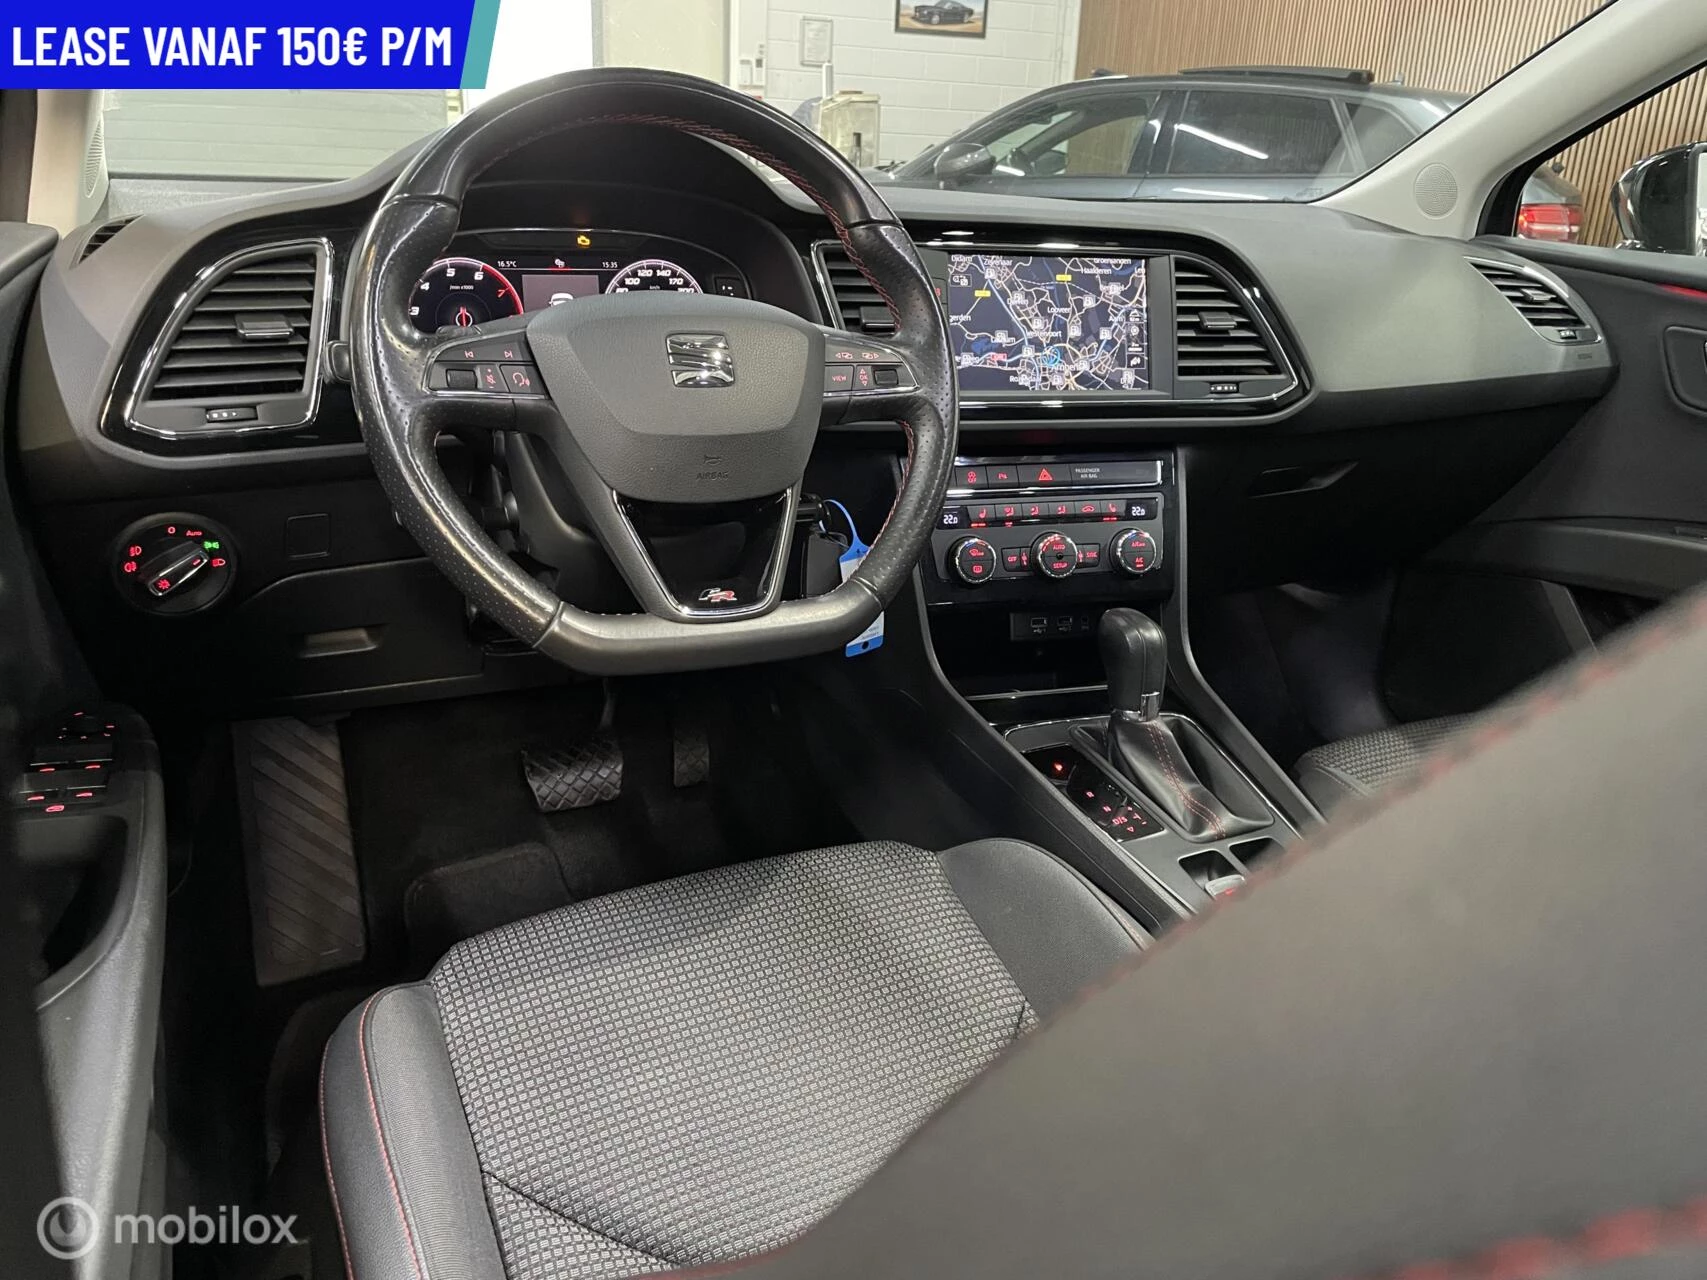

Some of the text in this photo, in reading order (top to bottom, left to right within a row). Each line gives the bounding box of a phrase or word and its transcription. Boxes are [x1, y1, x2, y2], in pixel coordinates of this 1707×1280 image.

[446, 268, 456, 277] 5
[474, 271, 484, 281] 6
[637, 269, 653, 277] 120
[656, 269, 672, 277] 140
[420, 282, 430, 291] 4
[497, 289, 506, 298] 7
[410, 306, 420, 315] 3
[696, 471, 728, 480] AIRBAG
